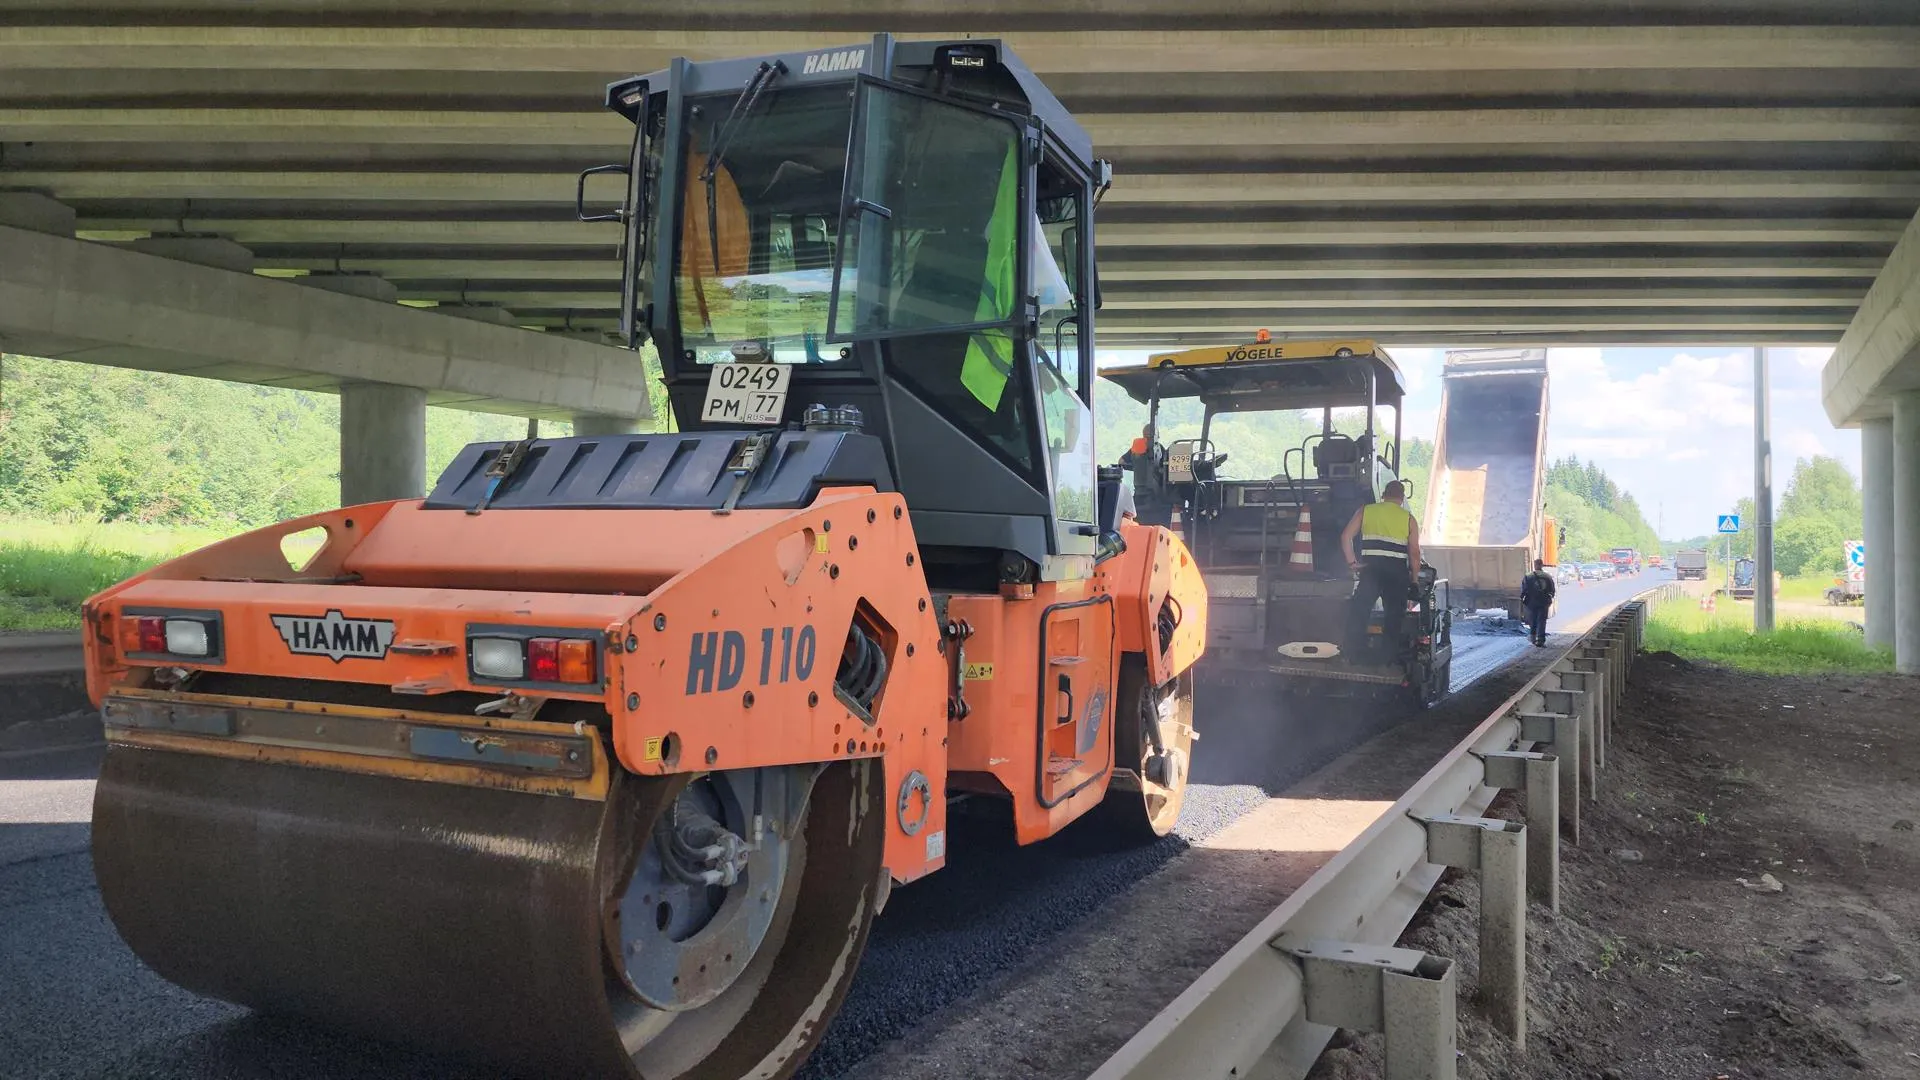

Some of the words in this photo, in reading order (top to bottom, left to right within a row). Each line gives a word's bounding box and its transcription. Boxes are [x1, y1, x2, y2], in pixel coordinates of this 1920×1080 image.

[803, 50, 864, 74] HAMM
[1227, 347, 1284, 361] VÖGELE
[720, 366, 780, 390] 0249
[756, 395, 779, 413] 77
[293, 621, 379, 653] HAMM
[685, 630, 746, 696] HD
[759, 624, 816, 685] 110
